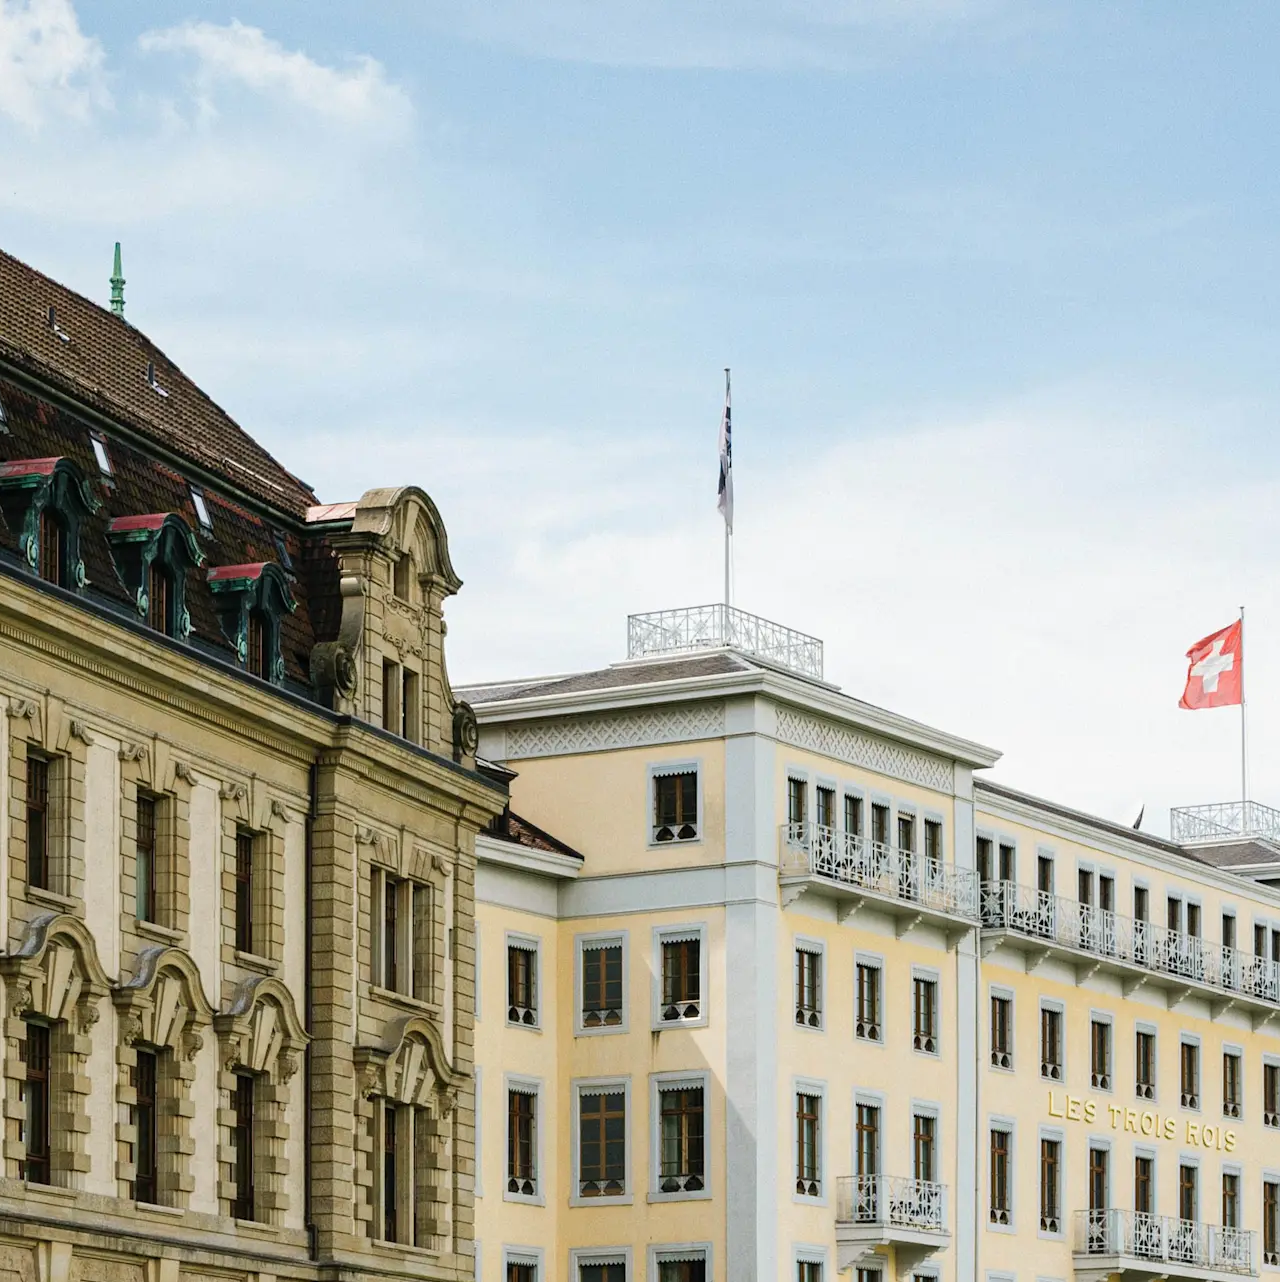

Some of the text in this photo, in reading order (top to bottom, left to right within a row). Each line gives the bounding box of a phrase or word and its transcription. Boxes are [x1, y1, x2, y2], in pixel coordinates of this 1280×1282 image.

[1048, 1091, 1237, 1152] LES TROIS ROIS
